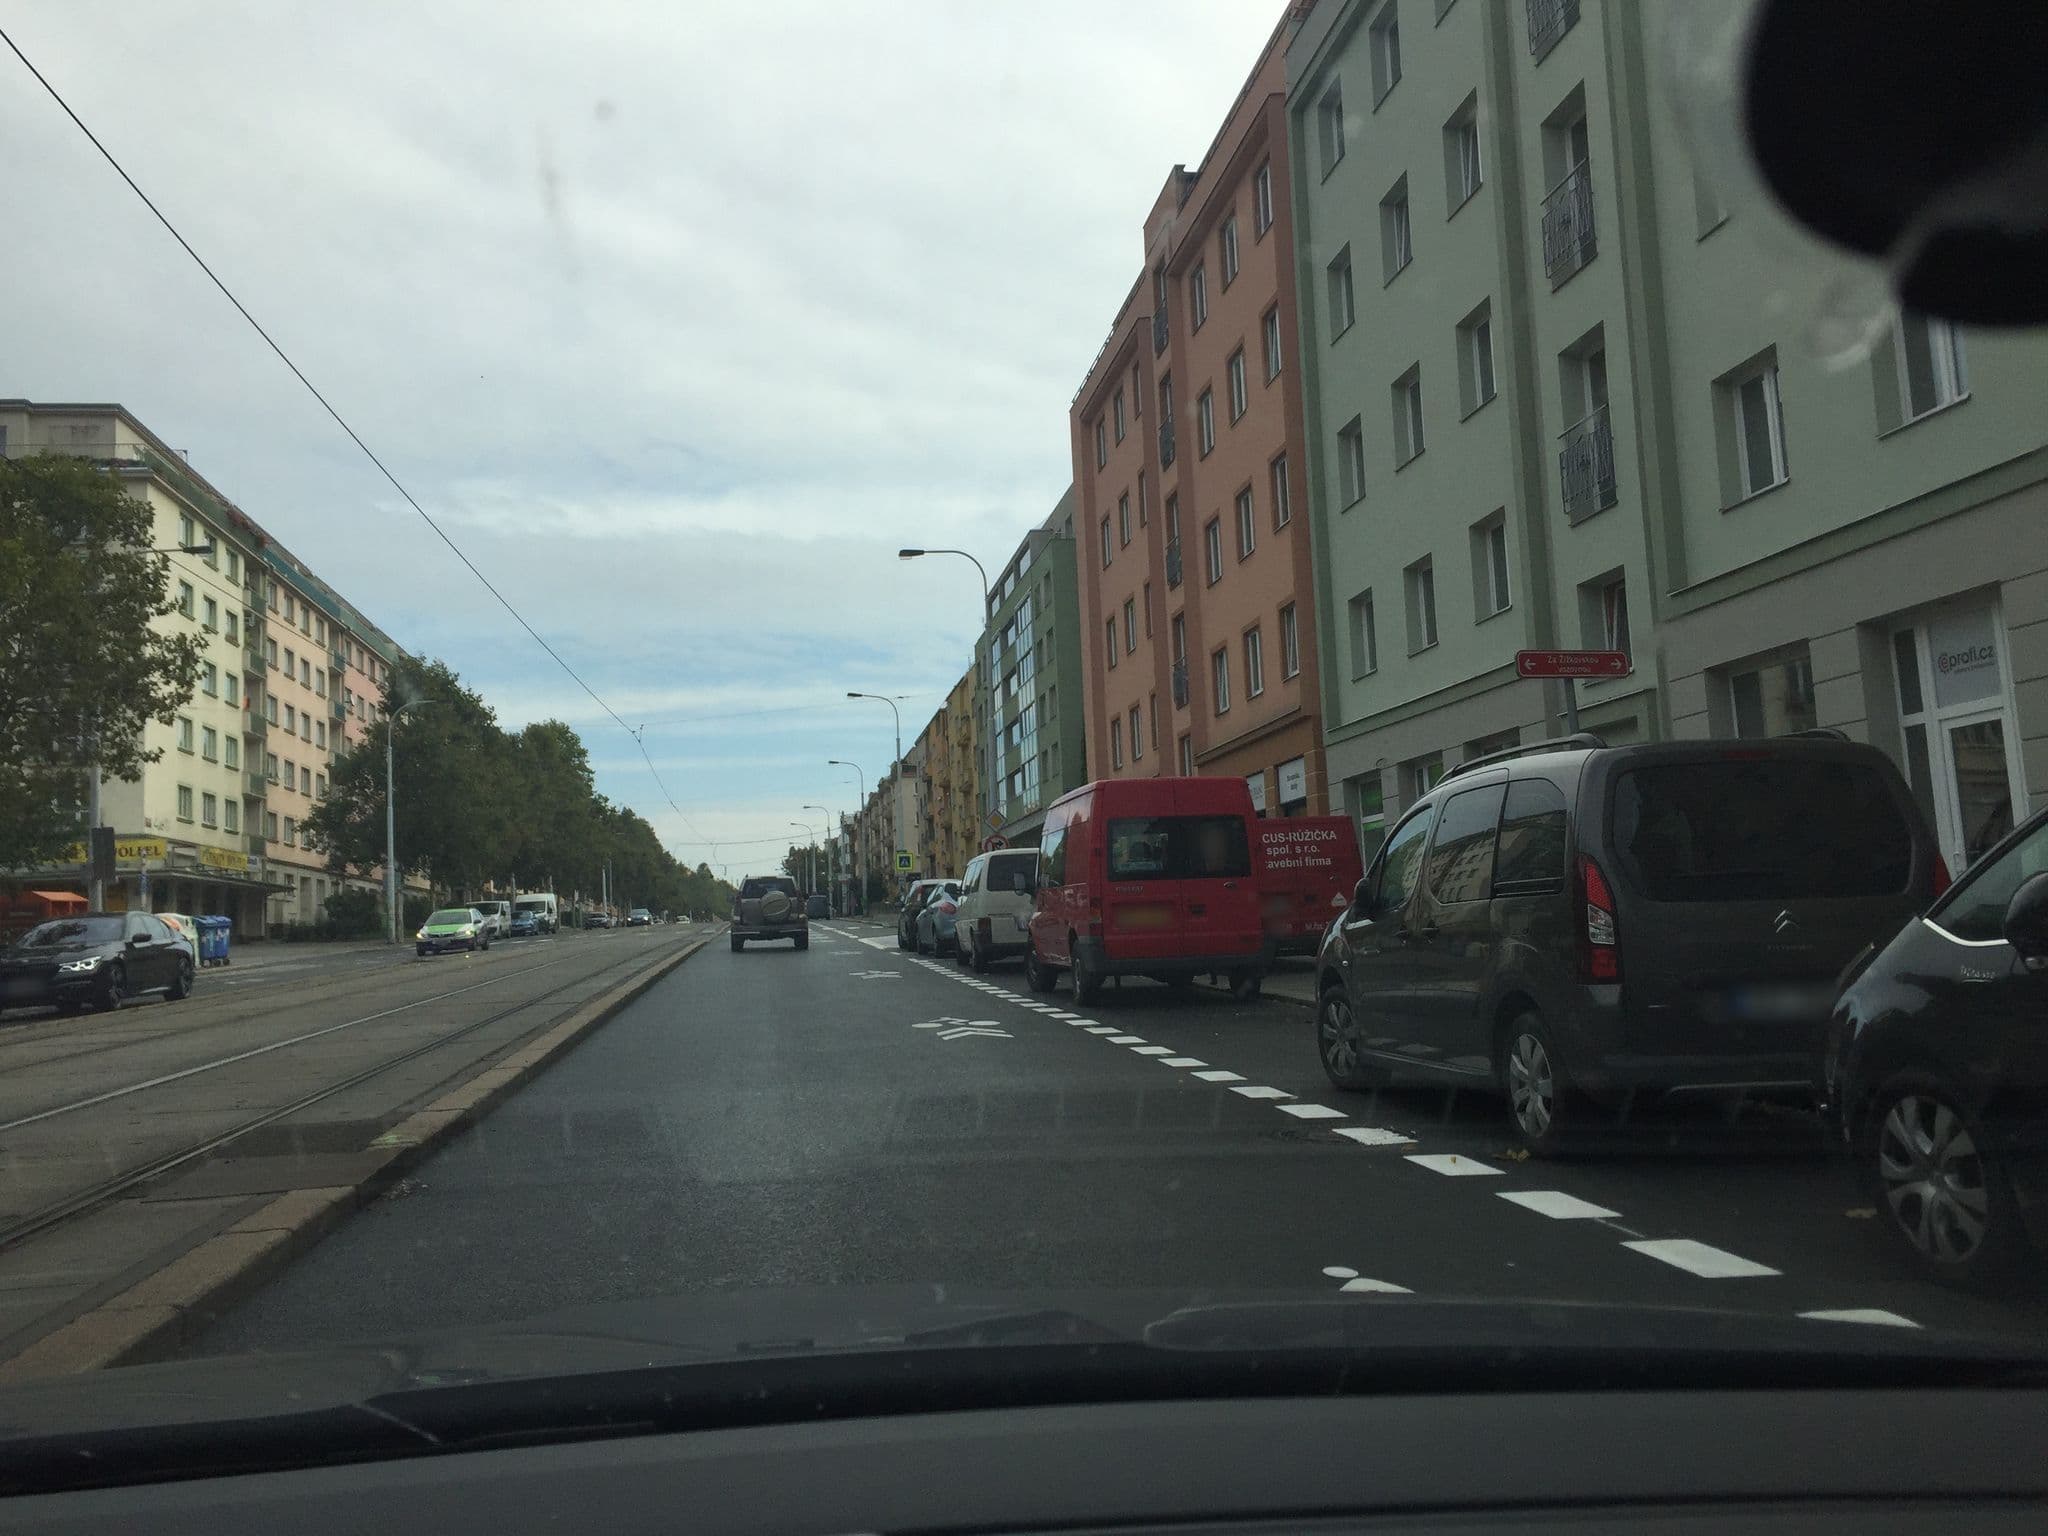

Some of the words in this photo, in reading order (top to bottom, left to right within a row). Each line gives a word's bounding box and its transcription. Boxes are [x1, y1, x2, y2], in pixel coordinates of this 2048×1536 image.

[1295, 846, 1302, 854] s
[1304, 845, 1320, 854] r.o.
[1305, 856, 1332, 866] firma
